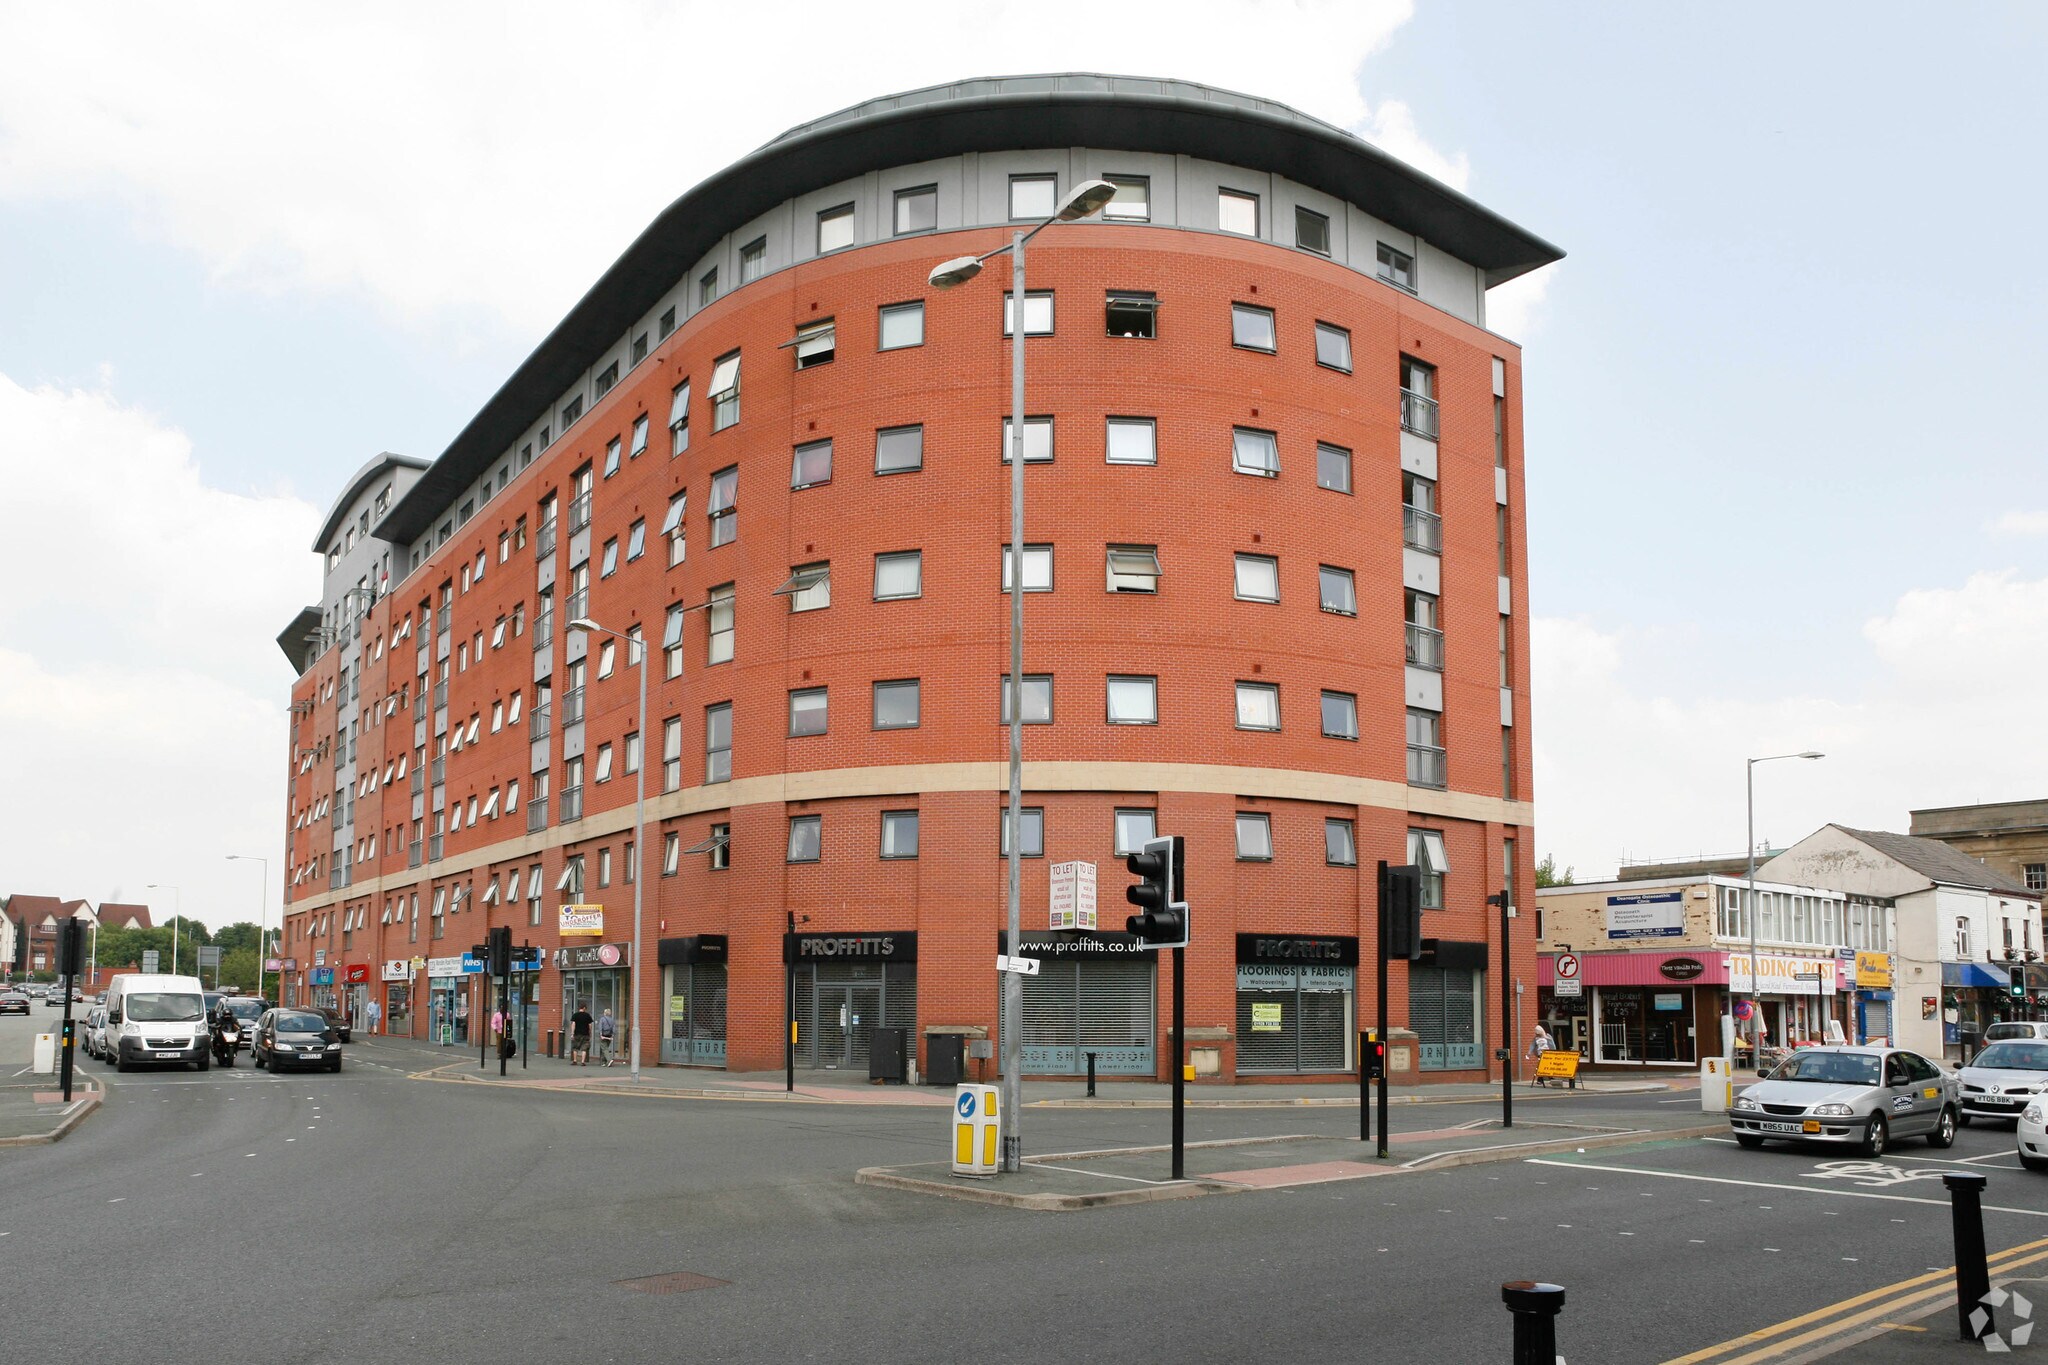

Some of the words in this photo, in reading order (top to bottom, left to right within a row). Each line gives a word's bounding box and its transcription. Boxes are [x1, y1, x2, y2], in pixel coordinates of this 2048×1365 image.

[1053, 866, 1060, 875] TO
[1063, 864, 1073, 874] LET
[1079, 864, 1086, 873] TO
[1087, 866, 1095, 875] LET
[1018, 937, 1143, 955] www.proffitts.co.uk
[1237, 966, 1296, 976] FLOORINGS
[1301, 968, 1308, 976] &
[1311, 968, 1350, 977] FABRICS
[1784, 1124, 1800, 1132] UAC
